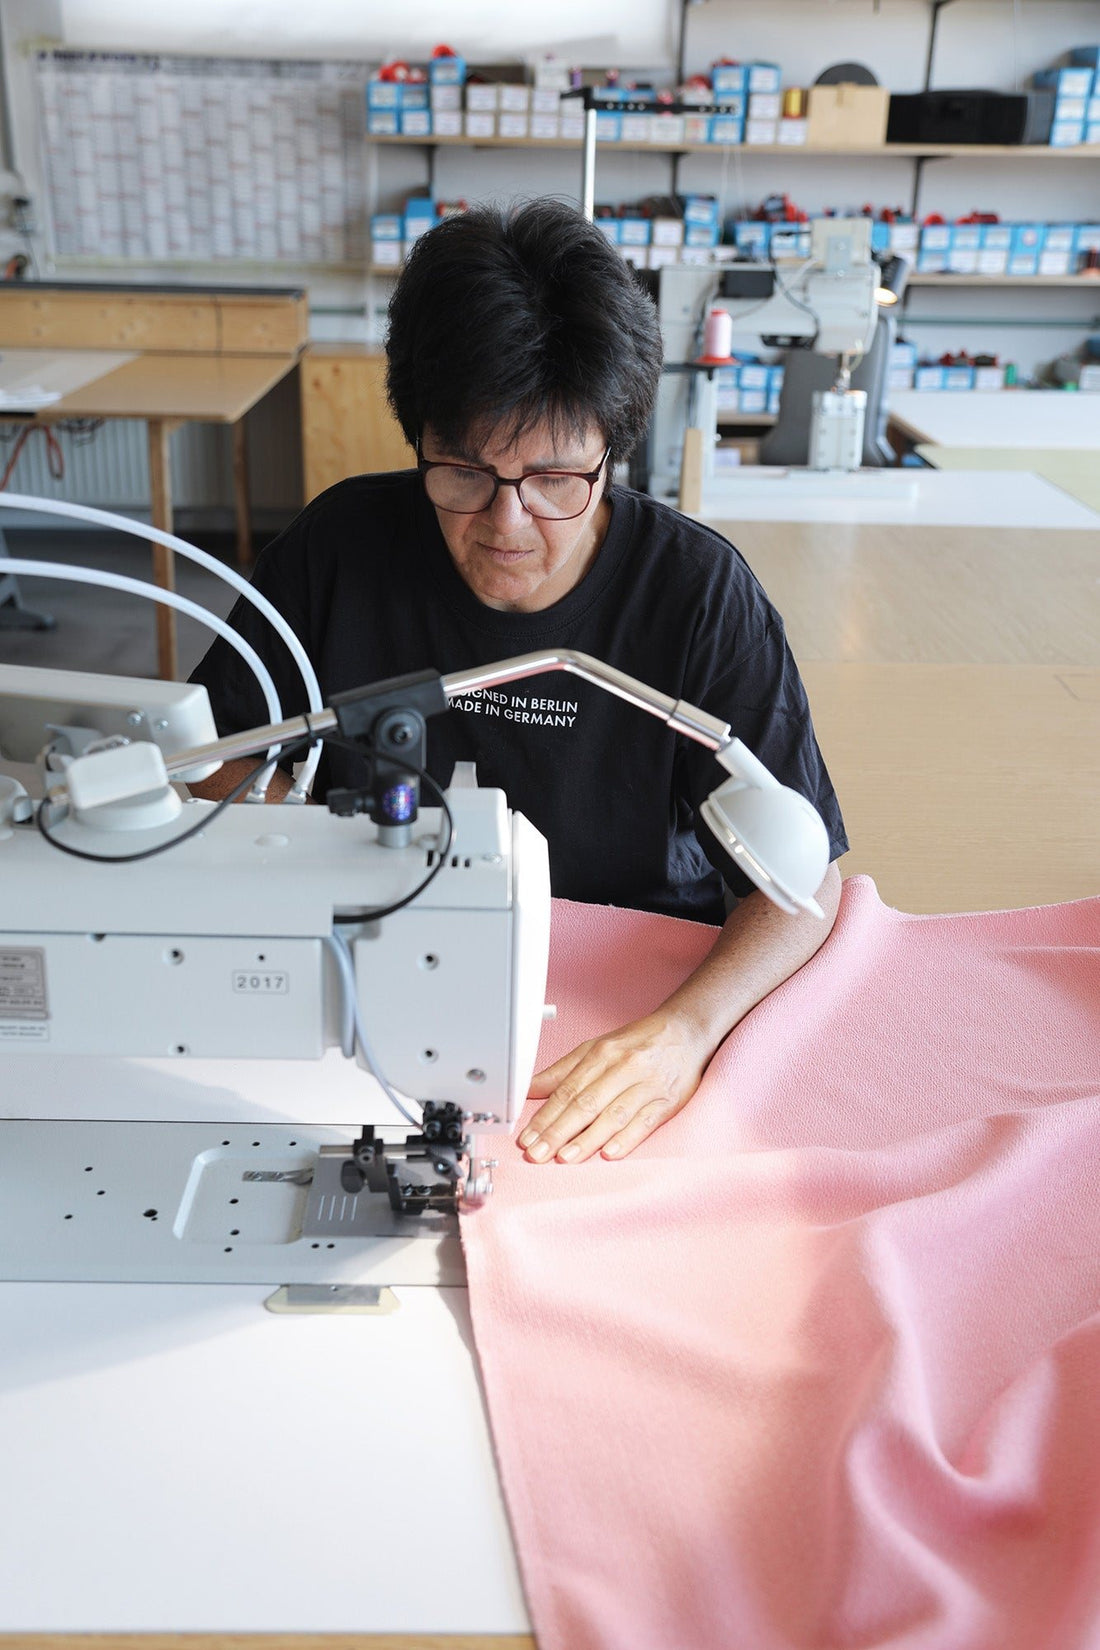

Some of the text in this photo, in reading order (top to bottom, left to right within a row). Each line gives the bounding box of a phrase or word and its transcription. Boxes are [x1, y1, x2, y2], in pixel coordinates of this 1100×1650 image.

[448, 696, 576, 728] MADE IN GERMANY
[511, 696, 527, 709] IN
[530, 698, 578, 713] BERLIN
[236, 975, 284, 989] 2017
